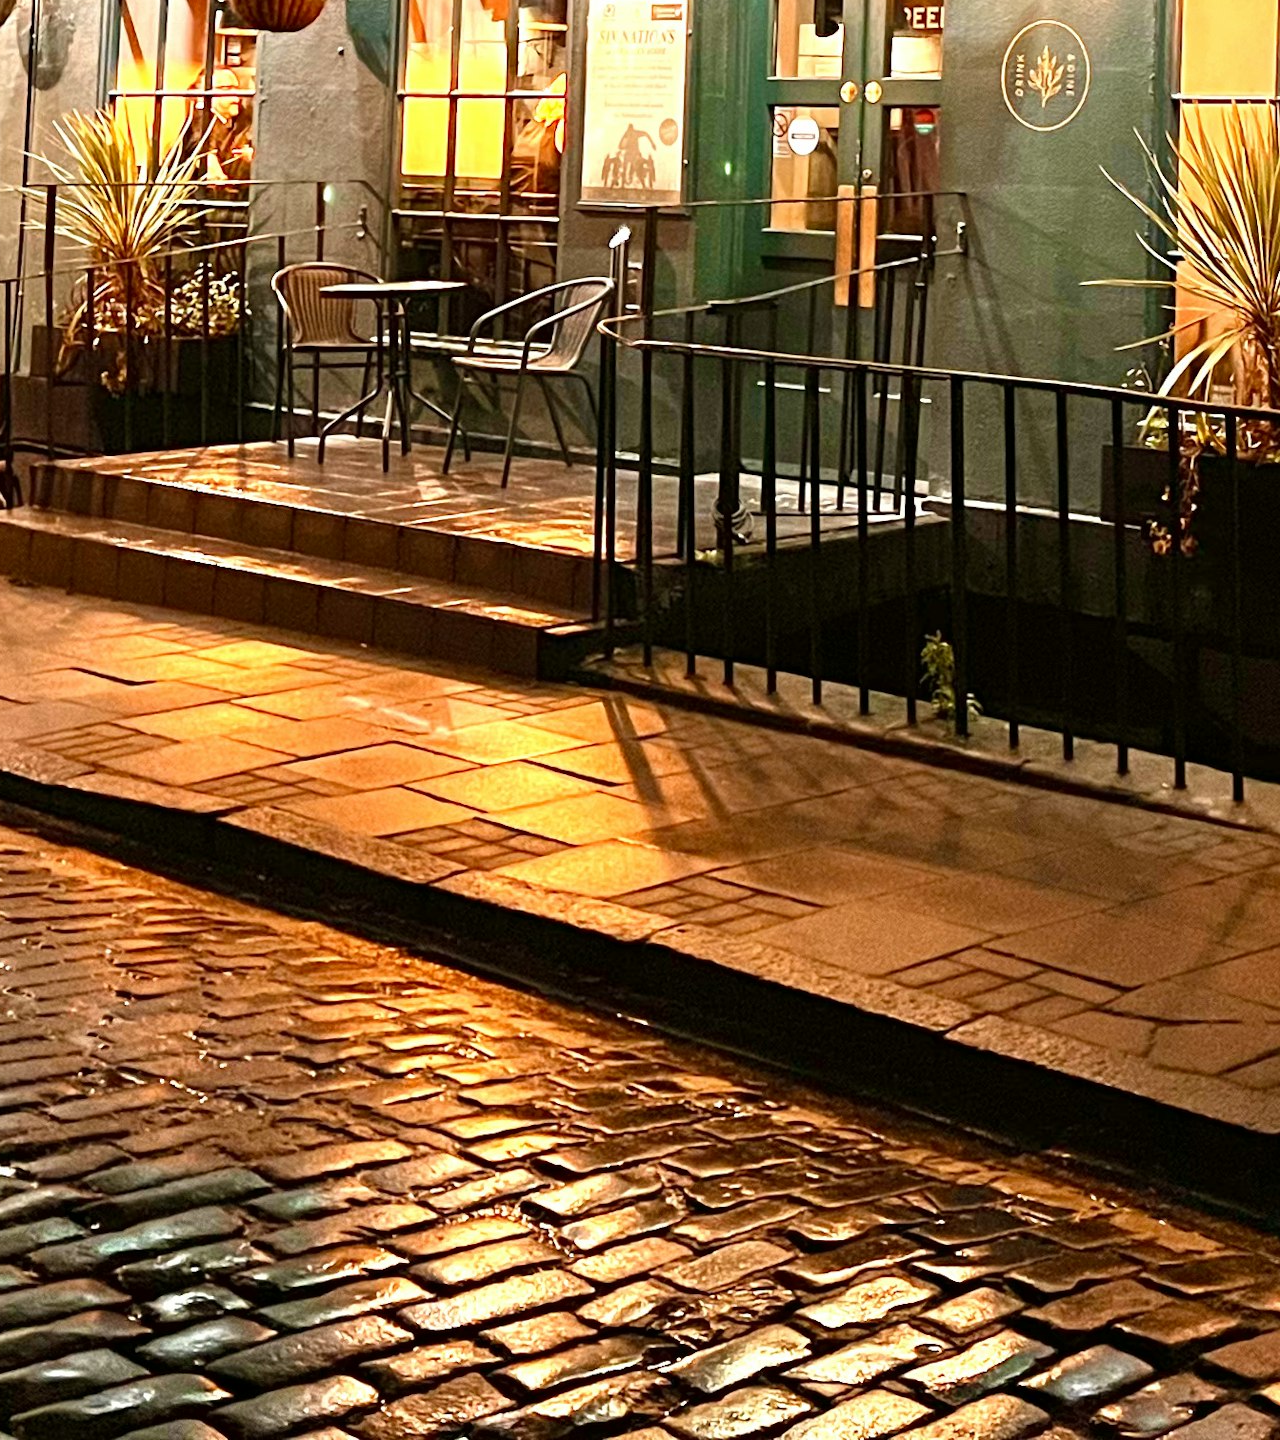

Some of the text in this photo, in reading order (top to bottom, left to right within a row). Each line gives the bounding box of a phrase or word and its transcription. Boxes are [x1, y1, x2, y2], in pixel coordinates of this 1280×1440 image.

[621, 29, 677, 45] NATIONS
[1014, 54, 1026, 97] DRINK
[1065, 64, 1076, 97] DINE
